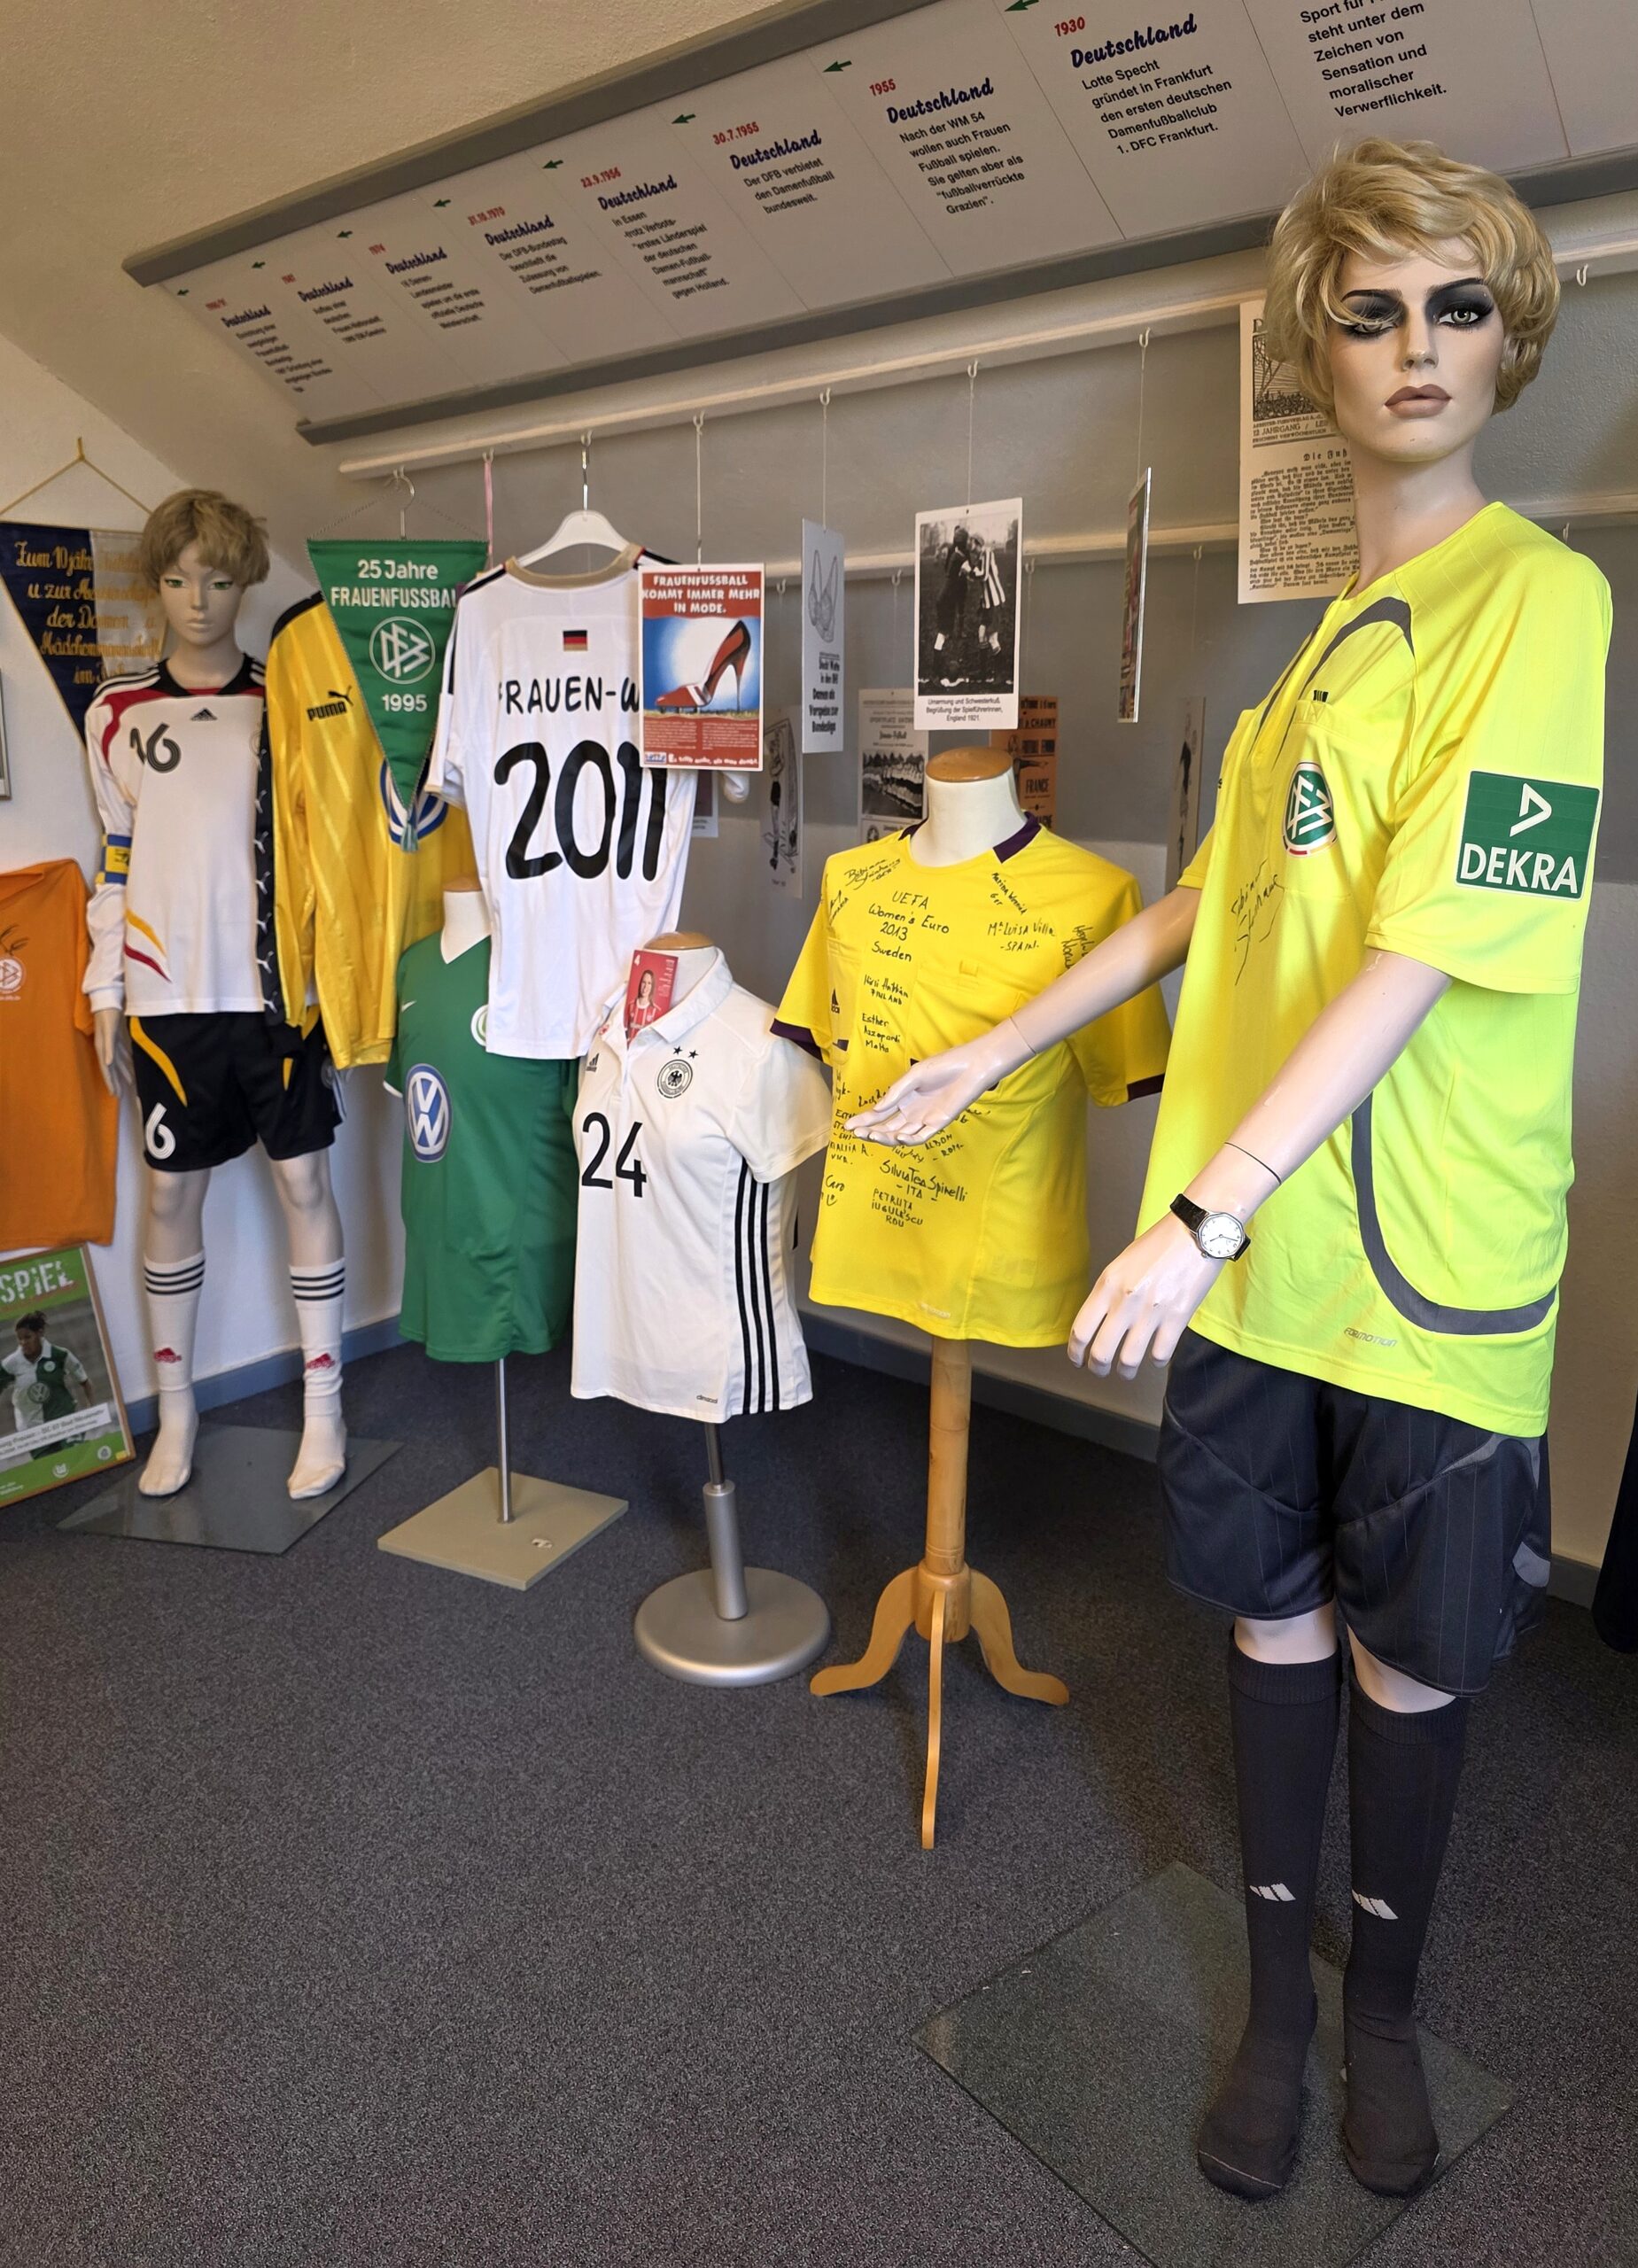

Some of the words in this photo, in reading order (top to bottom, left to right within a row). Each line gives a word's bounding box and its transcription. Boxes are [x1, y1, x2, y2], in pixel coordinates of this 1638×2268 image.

[1054, 17, 1085, 37] 1930
[1300, 3, 1341, 23] Sport
[1308, 24, 1345, 43] steht
[1347, 13, 1386, 32] unter
[1391, 4, 1425, 20] dem
[1070, 13, 1197, 68] Deutschland
[1314, 40, 1373, 62] Zeichen
[1376, 31, 1404, 46] von
[1082, 73, 1114, 90] Lotte
[1115, 59, 1161, 82] Specht
[1322, 53, 1394, 81] Sensation
[1398, 44, 1428, 62] und
[869, 78, 897, 97] 1955
[887, 77, 994, 123] Deutschland
[1091, 85, 1138, 109] gründet
[1140, 82, 1153, 94] in
[1154, 65, 1214, 89] Frankfurt
[1329, 70, 1415, 100] moralischer
[1334, 82, 1447, 118] Verwerflichkeit.
[1100, 110, 1123, 123] den
[1126, 98, 1164, 117] ersten
[1166, 80, 1232, 105] deutschen
[712, 120, 760, 145] 30.7.1955
[899, 128, 928, 144] Nach
[929, 122, 947, 135] der
[947, 117, 970, 130] WM
[970, 111, 985, 122] 54
[1107, 103, 1217, 139] Damenfußballclub
[730, 128, 823, 170] Deutschland
[909, 143, 944, 158] wollen
[945, 135, 972, 148] auch
[972, 122, 1011, 141] Frauen
[1117, 144, 1130, 154] 1.
[1130, 136, 1157, 151] DFC
[1158, 121, 1218, 144] Frankfurt.
[743, 177, 761, 188] Der
[761, 169, 782, 183] DFB
[782, 158, 825, 176] verbietet
[918, 154, 958, 173] Fußball
[959, 144, 1001, 163] spielen.
[928, 175, 946, 187] Sie
[947, 166, 980, 183] gelten
[981, 159, 1005, 174] aber
[1006, 153, 1024, 166] als
[597, 175, 678, 210] Deutschland
[754, 190, 773, 201] den
[772, 171, 835, 196] Damenfußball
[622, 211, 648, 224] Essen
[763, 193, 818, 214] bundesweit.
[485, 214, 555, 246] Deutschland
[385, 246, 447, 275] Deutschland
[643, 253, 656, 263] der
[657, 243, 698, 260] deutschen
[297, 276, 354, 303] Deutschland
[672, 285, 697, 299] gegen
[358, 559, 381, 579] 25
[384, 559, 439, 580] Jahre
[653, 574, 749, 586] FRAUENFUSSBALL
[643, 588, 683, 601] KOMMT
[687, 588, 725, 601] IMMER
[728, 587, 760, 600] MEHR
[673, 602, 687, 614] IN
[690, 602, 726, 614] MODE.
[46, 605, 76, 628] der
[307, 701, 348, 721] PUMA
[382, 694, 428, 712] 1995
[493, 740, 668, 882] 2011
[1460, 843, 1579, 894] DEKRA
[880, 921, 908, 941] 2013
[921, 914, 950, 934] Euro
[872, 941, 912, 962] Sweden
[862, 1013, 889, 1028] Esther
[145, 1102, 176, 1161] 6
[581, 1111, 648, 1199] 24
